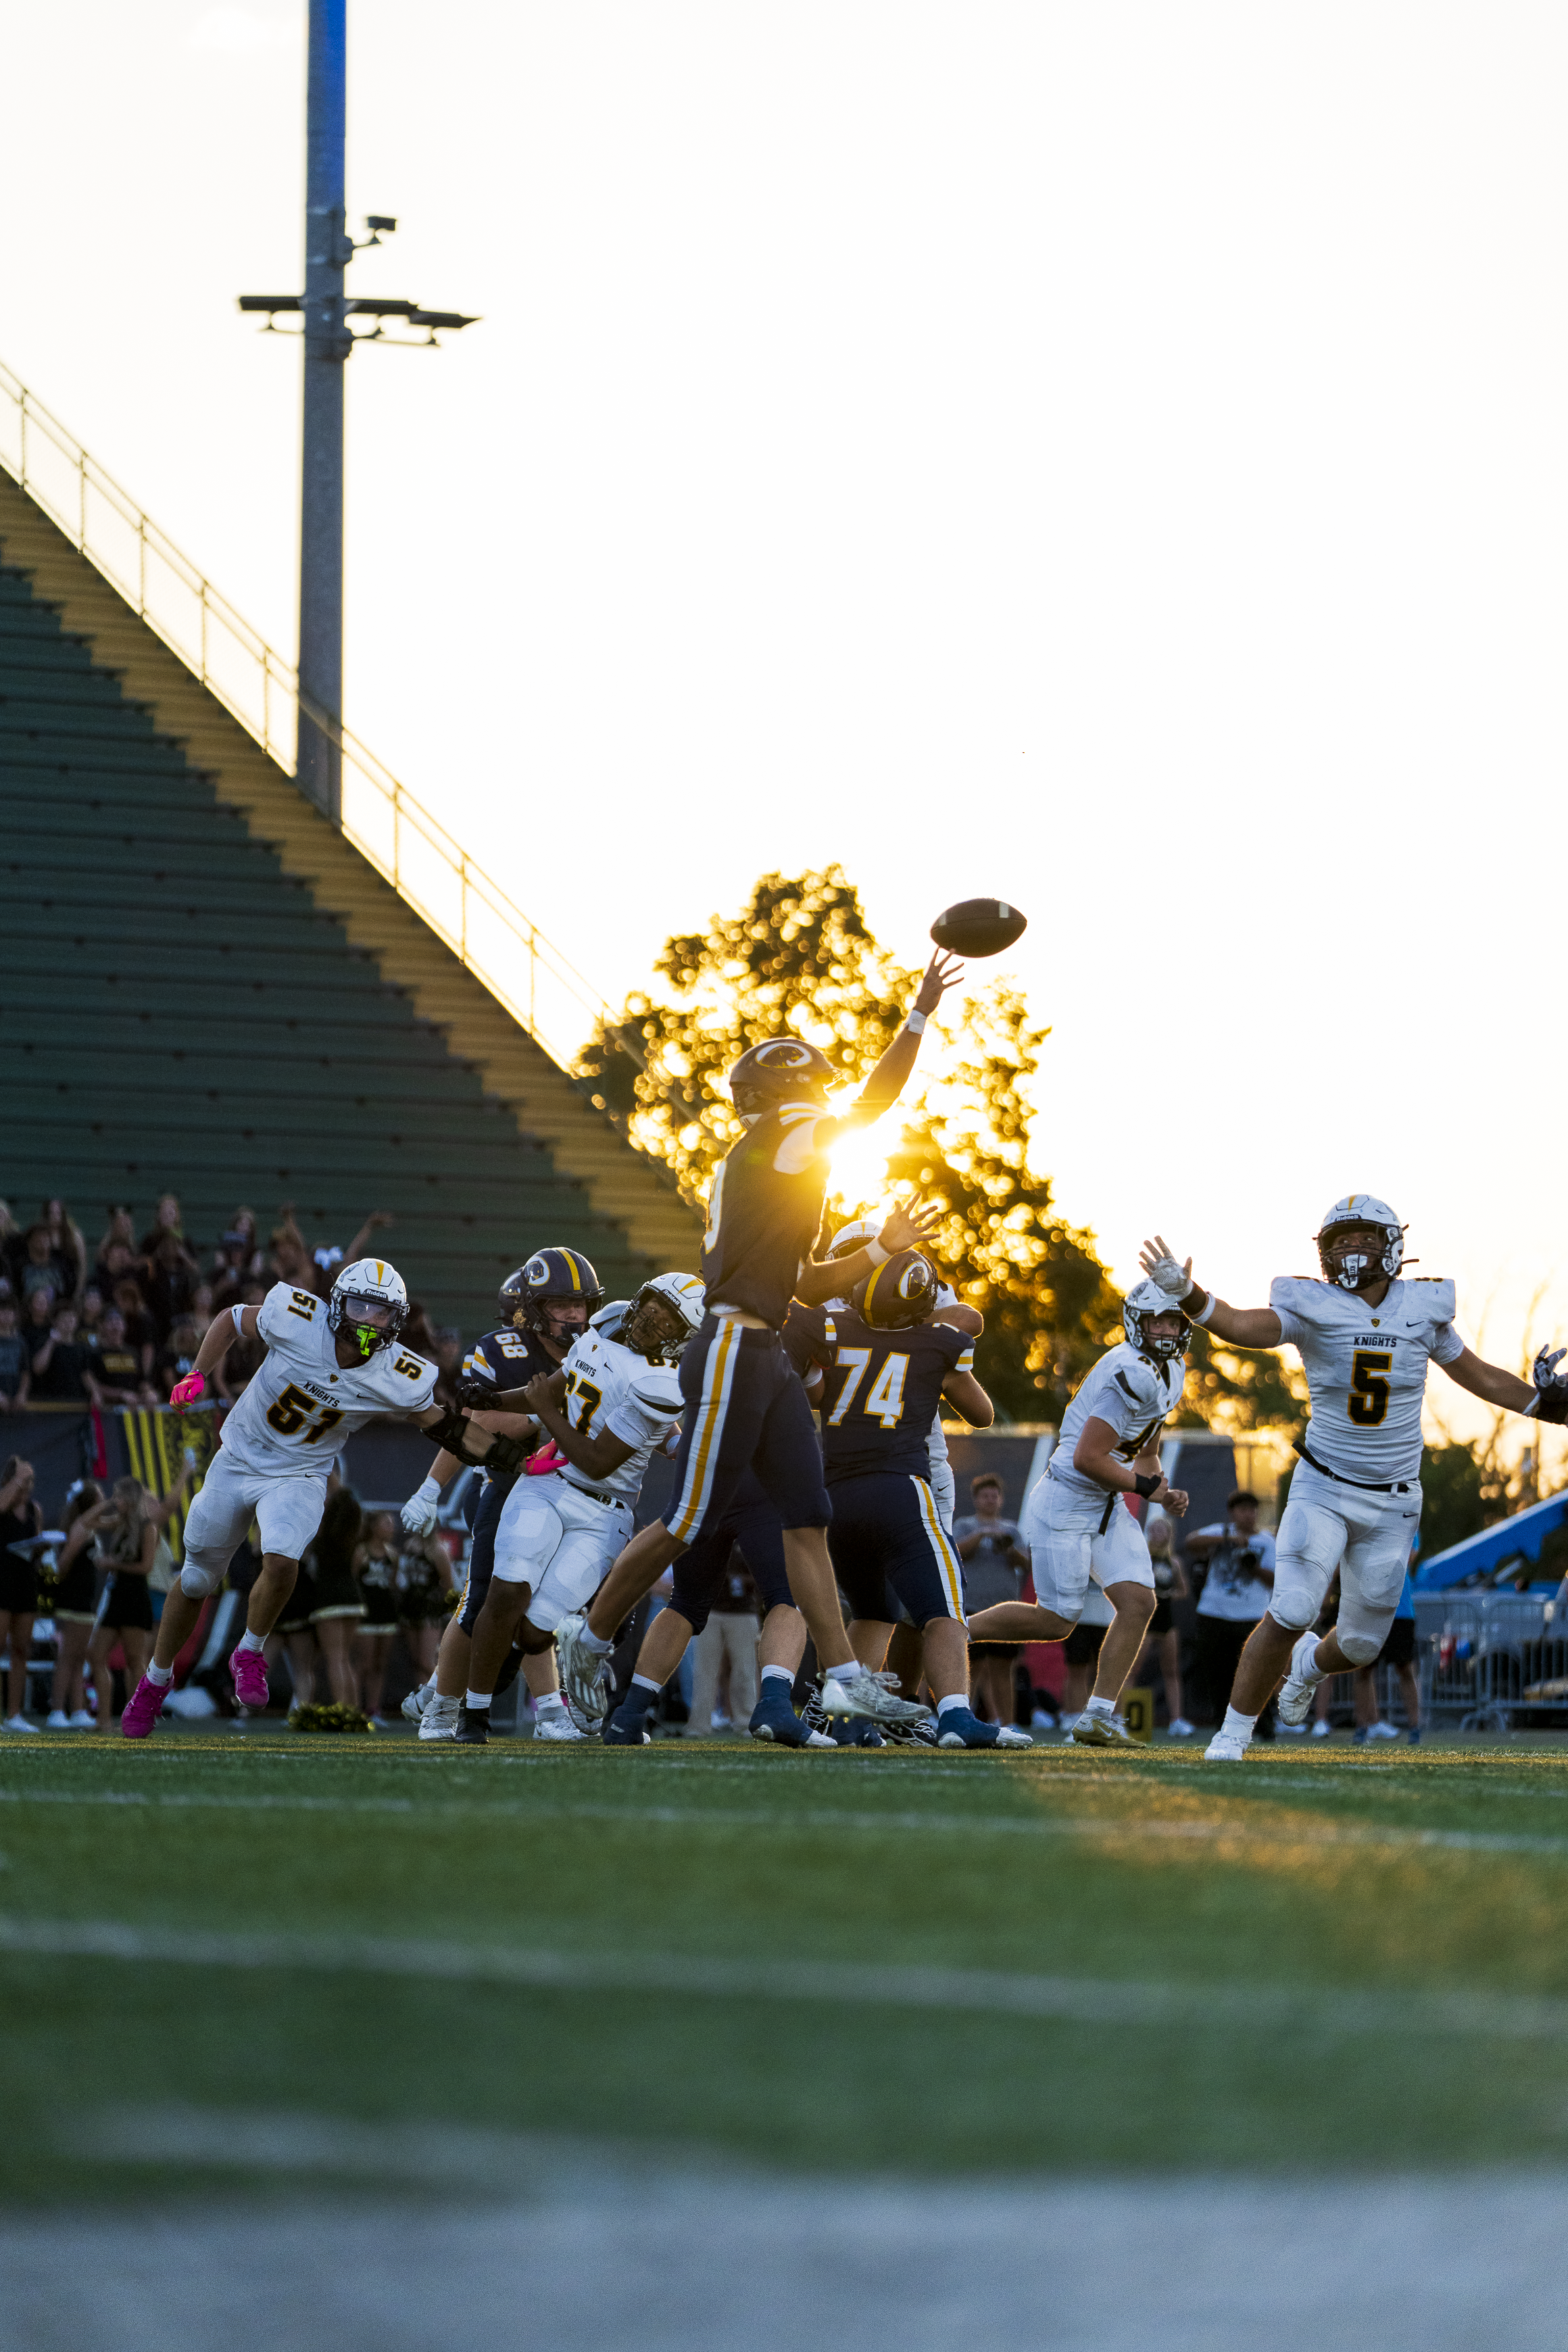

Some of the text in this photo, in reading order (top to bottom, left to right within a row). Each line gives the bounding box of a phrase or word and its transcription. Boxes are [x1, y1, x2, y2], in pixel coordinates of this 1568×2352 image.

[287, 1291, 317, 1322] 51
[366, 1290, 387, 1298] Riddell
[663, 1290, 680, 1305] Riddell
[494, 1332, 529, 1358] 68
[1353, 1336, 1397, 1347] KNIGHTS
[393, 1350, 426, 1380] 51
[574, 1358, 597, 1377] KNIGHTS
[303, 1381, 340, 1407] KNIGHTS
[827, 1346, 910, 1428] 74
[1347, 1350, 1392, 1427] 5
[266, 1382, 345, 1444] 51
